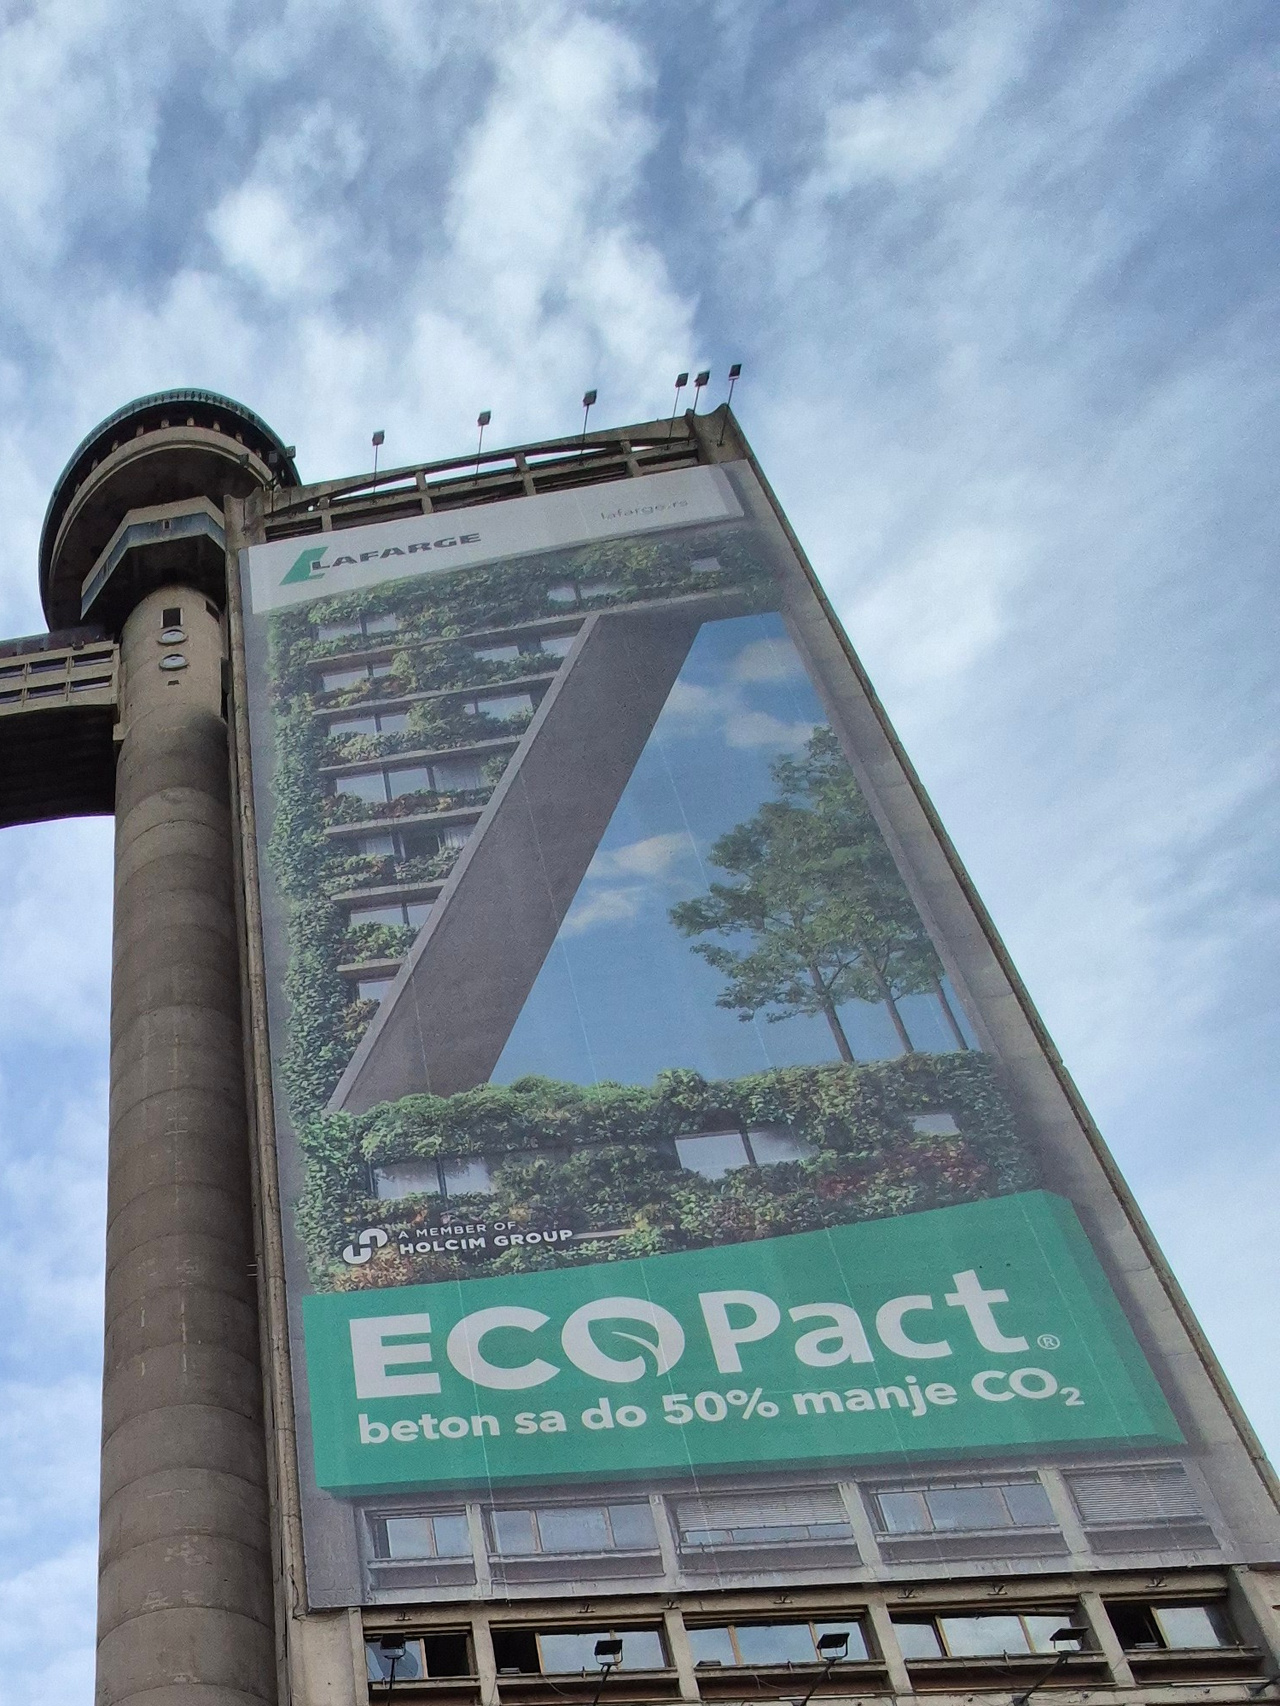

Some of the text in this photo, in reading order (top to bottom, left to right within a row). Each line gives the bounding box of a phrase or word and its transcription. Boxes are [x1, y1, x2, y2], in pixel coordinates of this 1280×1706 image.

[311, 532, 482, 572] LAFARGE
[398, 1221, 516, 1239] A MEMBER OF
[399, 1229, 573, 1255] HOLCIM GROUP
[358, 1413, 501, 1444] beton
[515, 1410, 568, 1435] sa
[581, 1397, 647, 1430] do
[662, 1387, 779, 1424] 50%
[792, 1375, 958, 1416] manje
